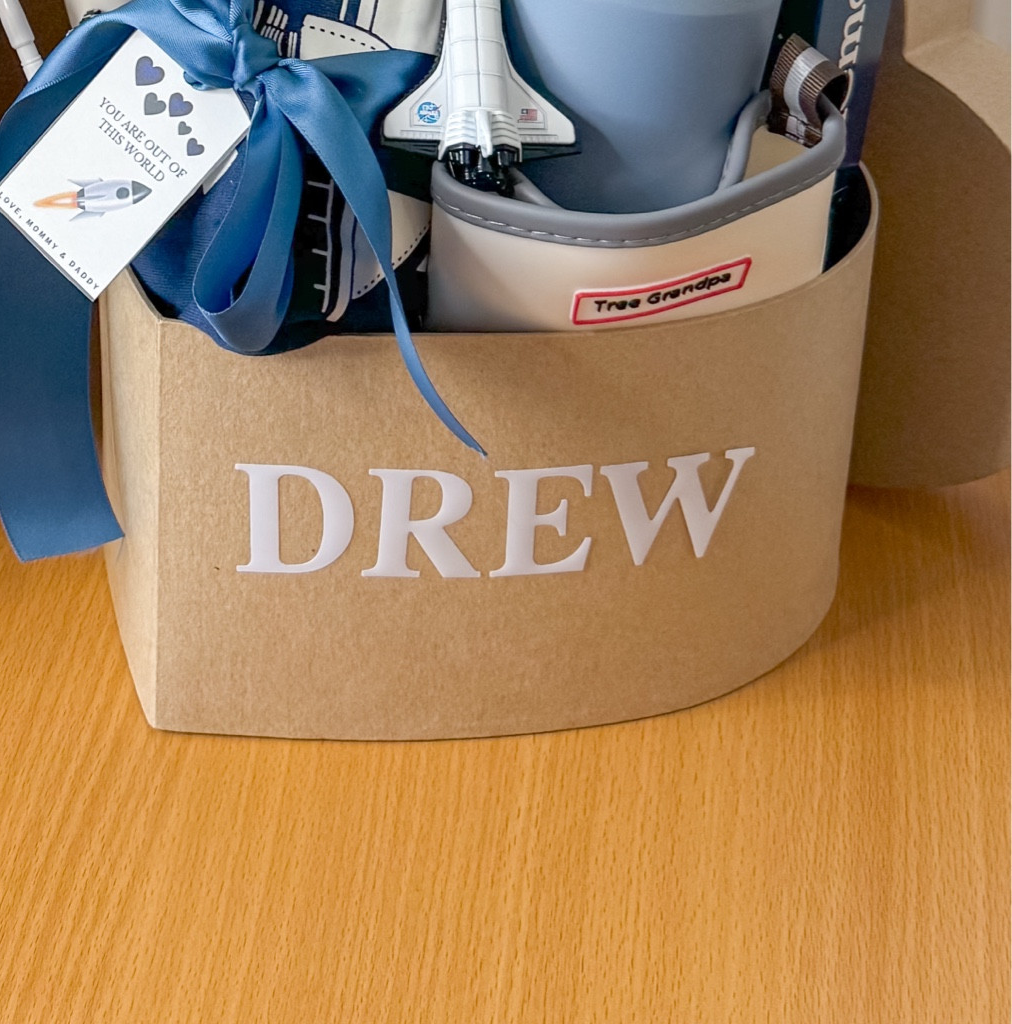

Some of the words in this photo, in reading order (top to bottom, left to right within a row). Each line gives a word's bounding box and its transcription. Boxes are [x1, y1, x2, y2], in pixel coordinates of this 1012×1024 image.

[98, 118, 124, 146] THIS
[123, 141, 166, 183] WORLD
[99, 96, 124, 122] YOU
[120, 118, 146, 144] ARE
[144, 139, 172, 165] OUT
[168, 161, 188, 179] OF
[25, 218, 59, 251] MOMMY
[68, 260, 101, 291] DADDY
[594, 298, 641, 313] Tree
[646, 272, 732, 305] Grandpa
[234, 446, 756, 578] DREW
